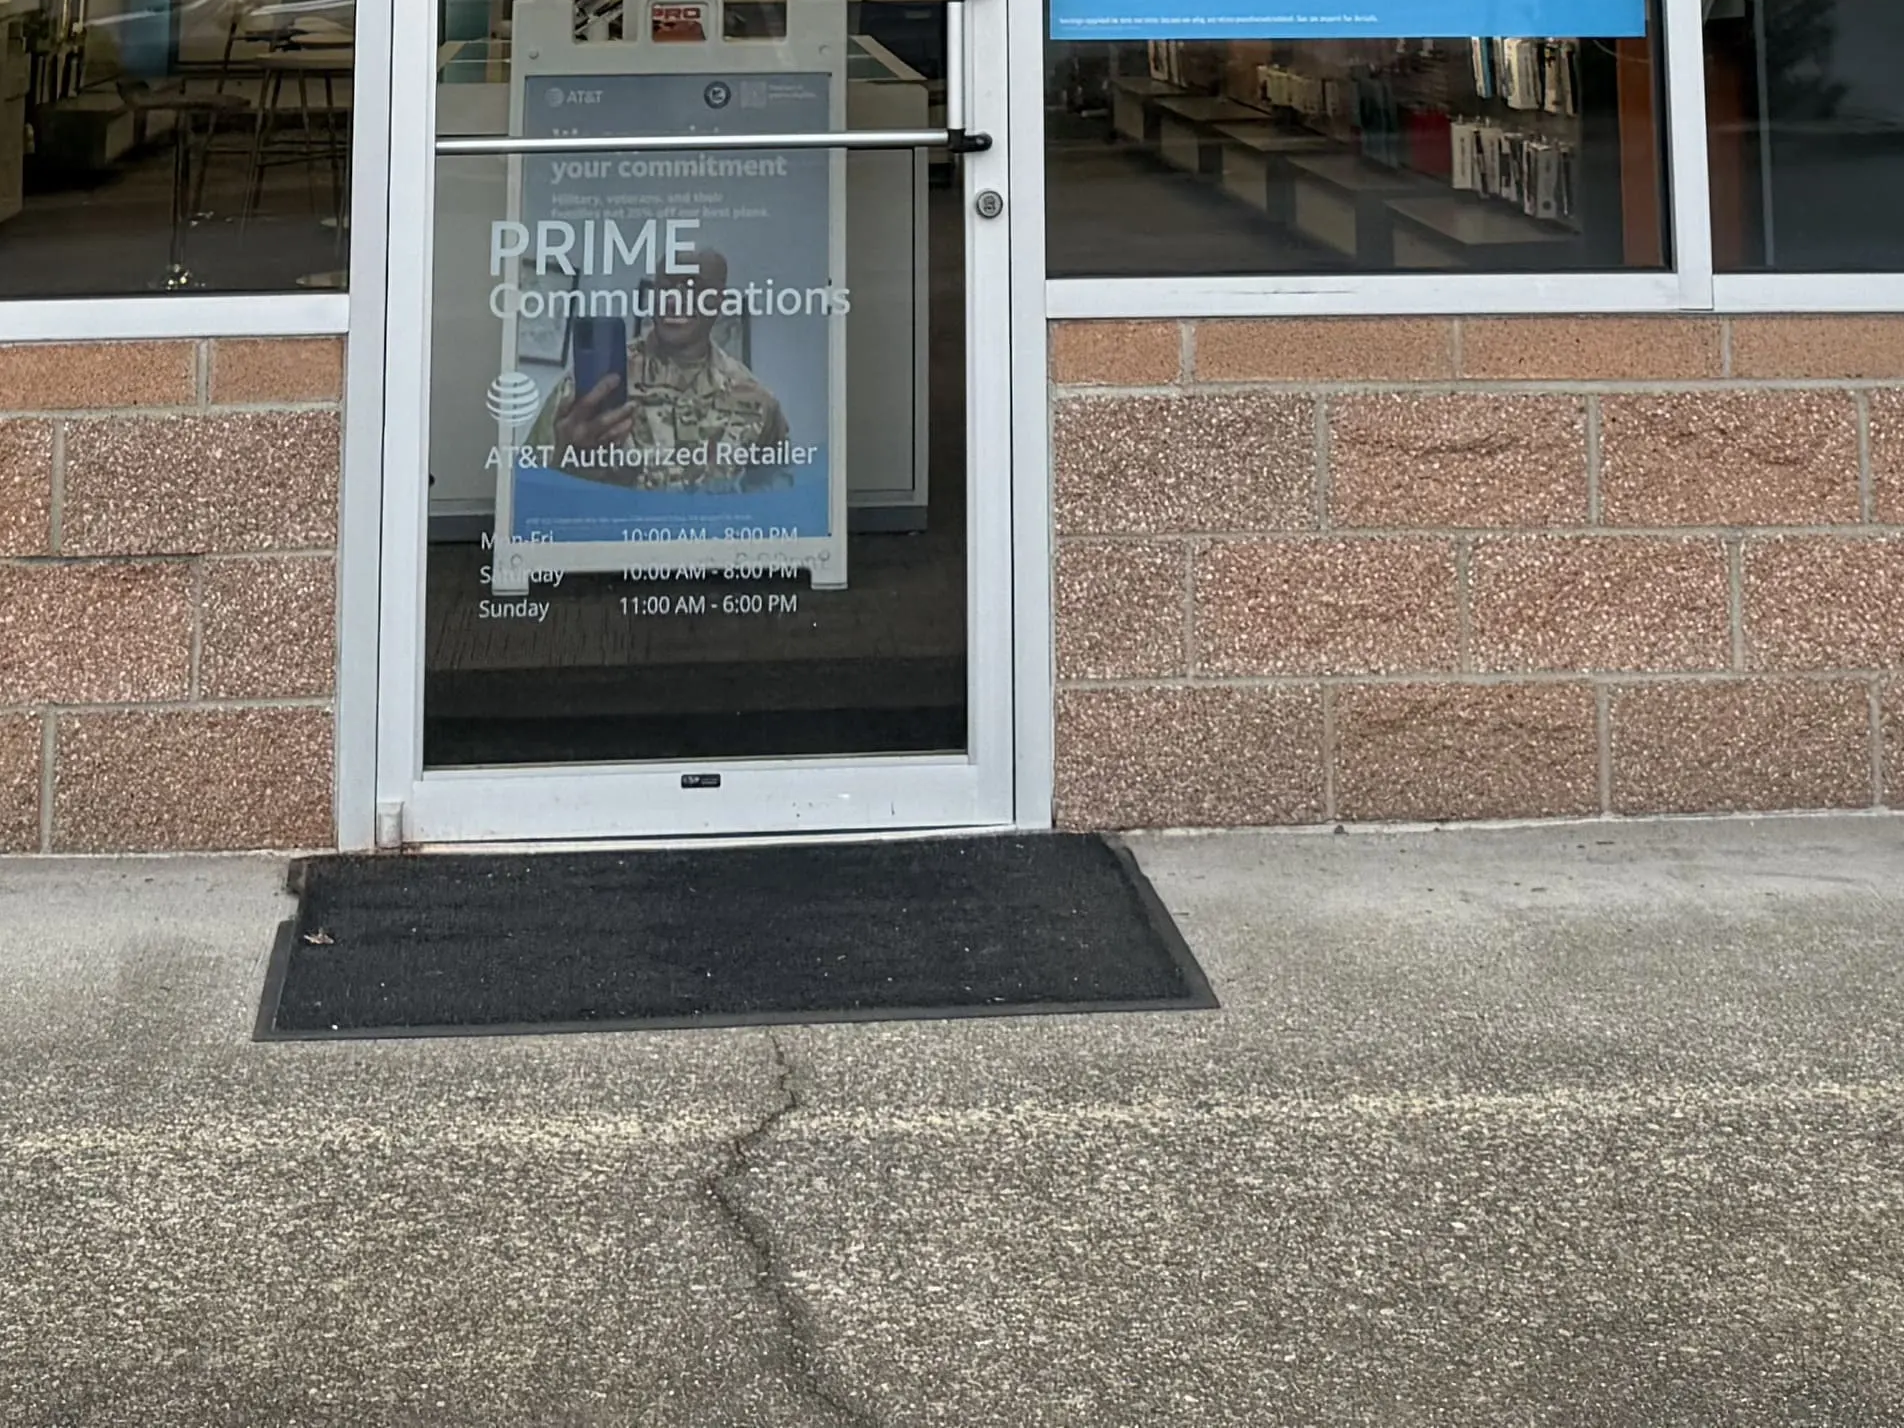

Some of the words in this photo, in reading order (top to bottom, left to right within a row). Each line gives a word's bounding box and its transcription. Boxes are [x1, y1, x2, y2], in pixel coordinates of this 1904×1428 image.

[565, 89, 604, 105] AT&T
[551, 159, 613, 185] your
[617, 153, 788, 179] commitment
[490, 218, 701, 277] PRIME
[488, 278, 851, 320] Communications
[484, 444, 555, 470] AT&T
[560, 442, 708, 468] Authorized
[716, 440, 818, 466] Retailer
[480, 530, 556, 551] Mn-Fri
[621, 528, 672, 547] 10:00
[676, 528, 707, 546] AM
[723, 527, 763, 546] 8:00
[768, 526, 799, 545] PM
[621, 563, 672, 582] 10:00
[676, 563, 706, 581] AM
[723, 562, 763, 581] 8:00
[768, 561, 798, 579] PM
[478, 600, 550, 623] Sunday
[619, 596, 671, 616] 11:00
[675, 596, 706, 615] AM
[722, 595, 763, 614] 6:00
[768, 594, 798, 613] PM
